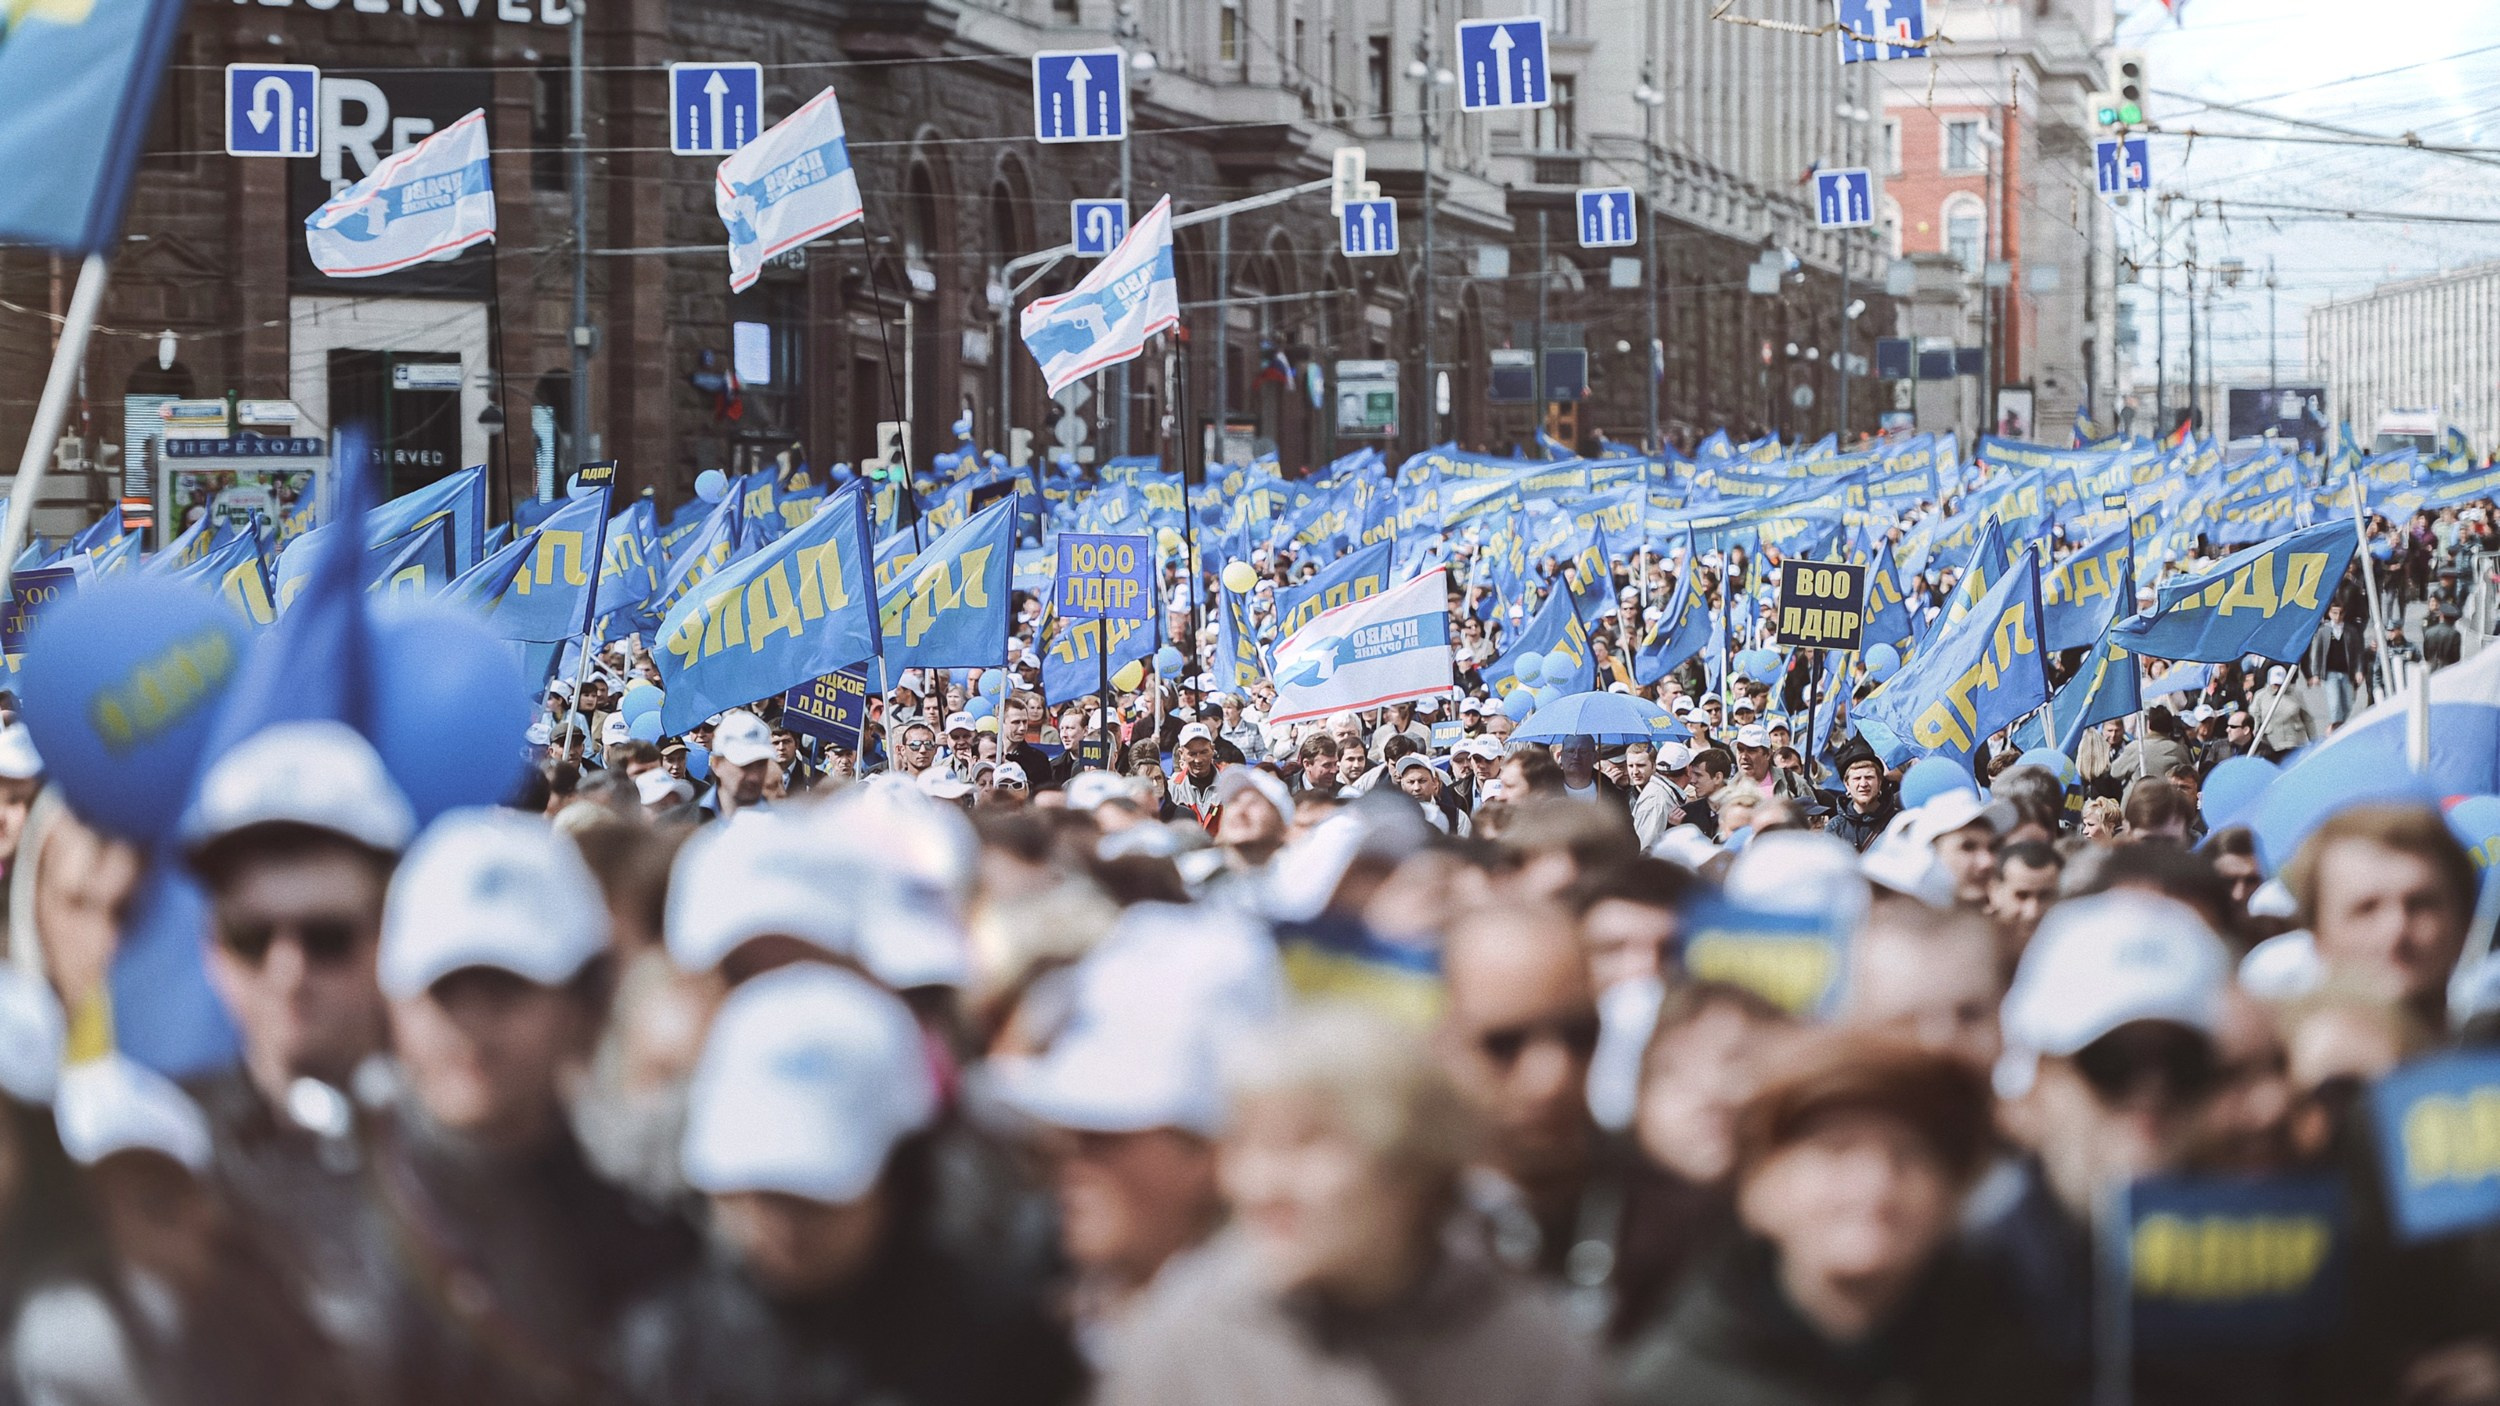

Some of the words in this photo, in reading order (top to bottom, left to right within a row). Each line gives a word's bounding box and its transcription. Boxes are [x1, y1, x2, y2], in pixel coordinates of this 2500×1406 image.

[184, 440, 302, 455] ПЕРЕХОД
[581, 467, 612, 480] ЛДПР
[1065, 577, 1139, 613] ЛДПР
[1795, 567, 1851, 600] ВОО
[1780, 606, 1860, 643] ЛДПР
[815, 683, 837, 702] ОО
[798, 695, 848, 722] ЛДПР
[1434, 726, 1462, 740] ЛДПР
